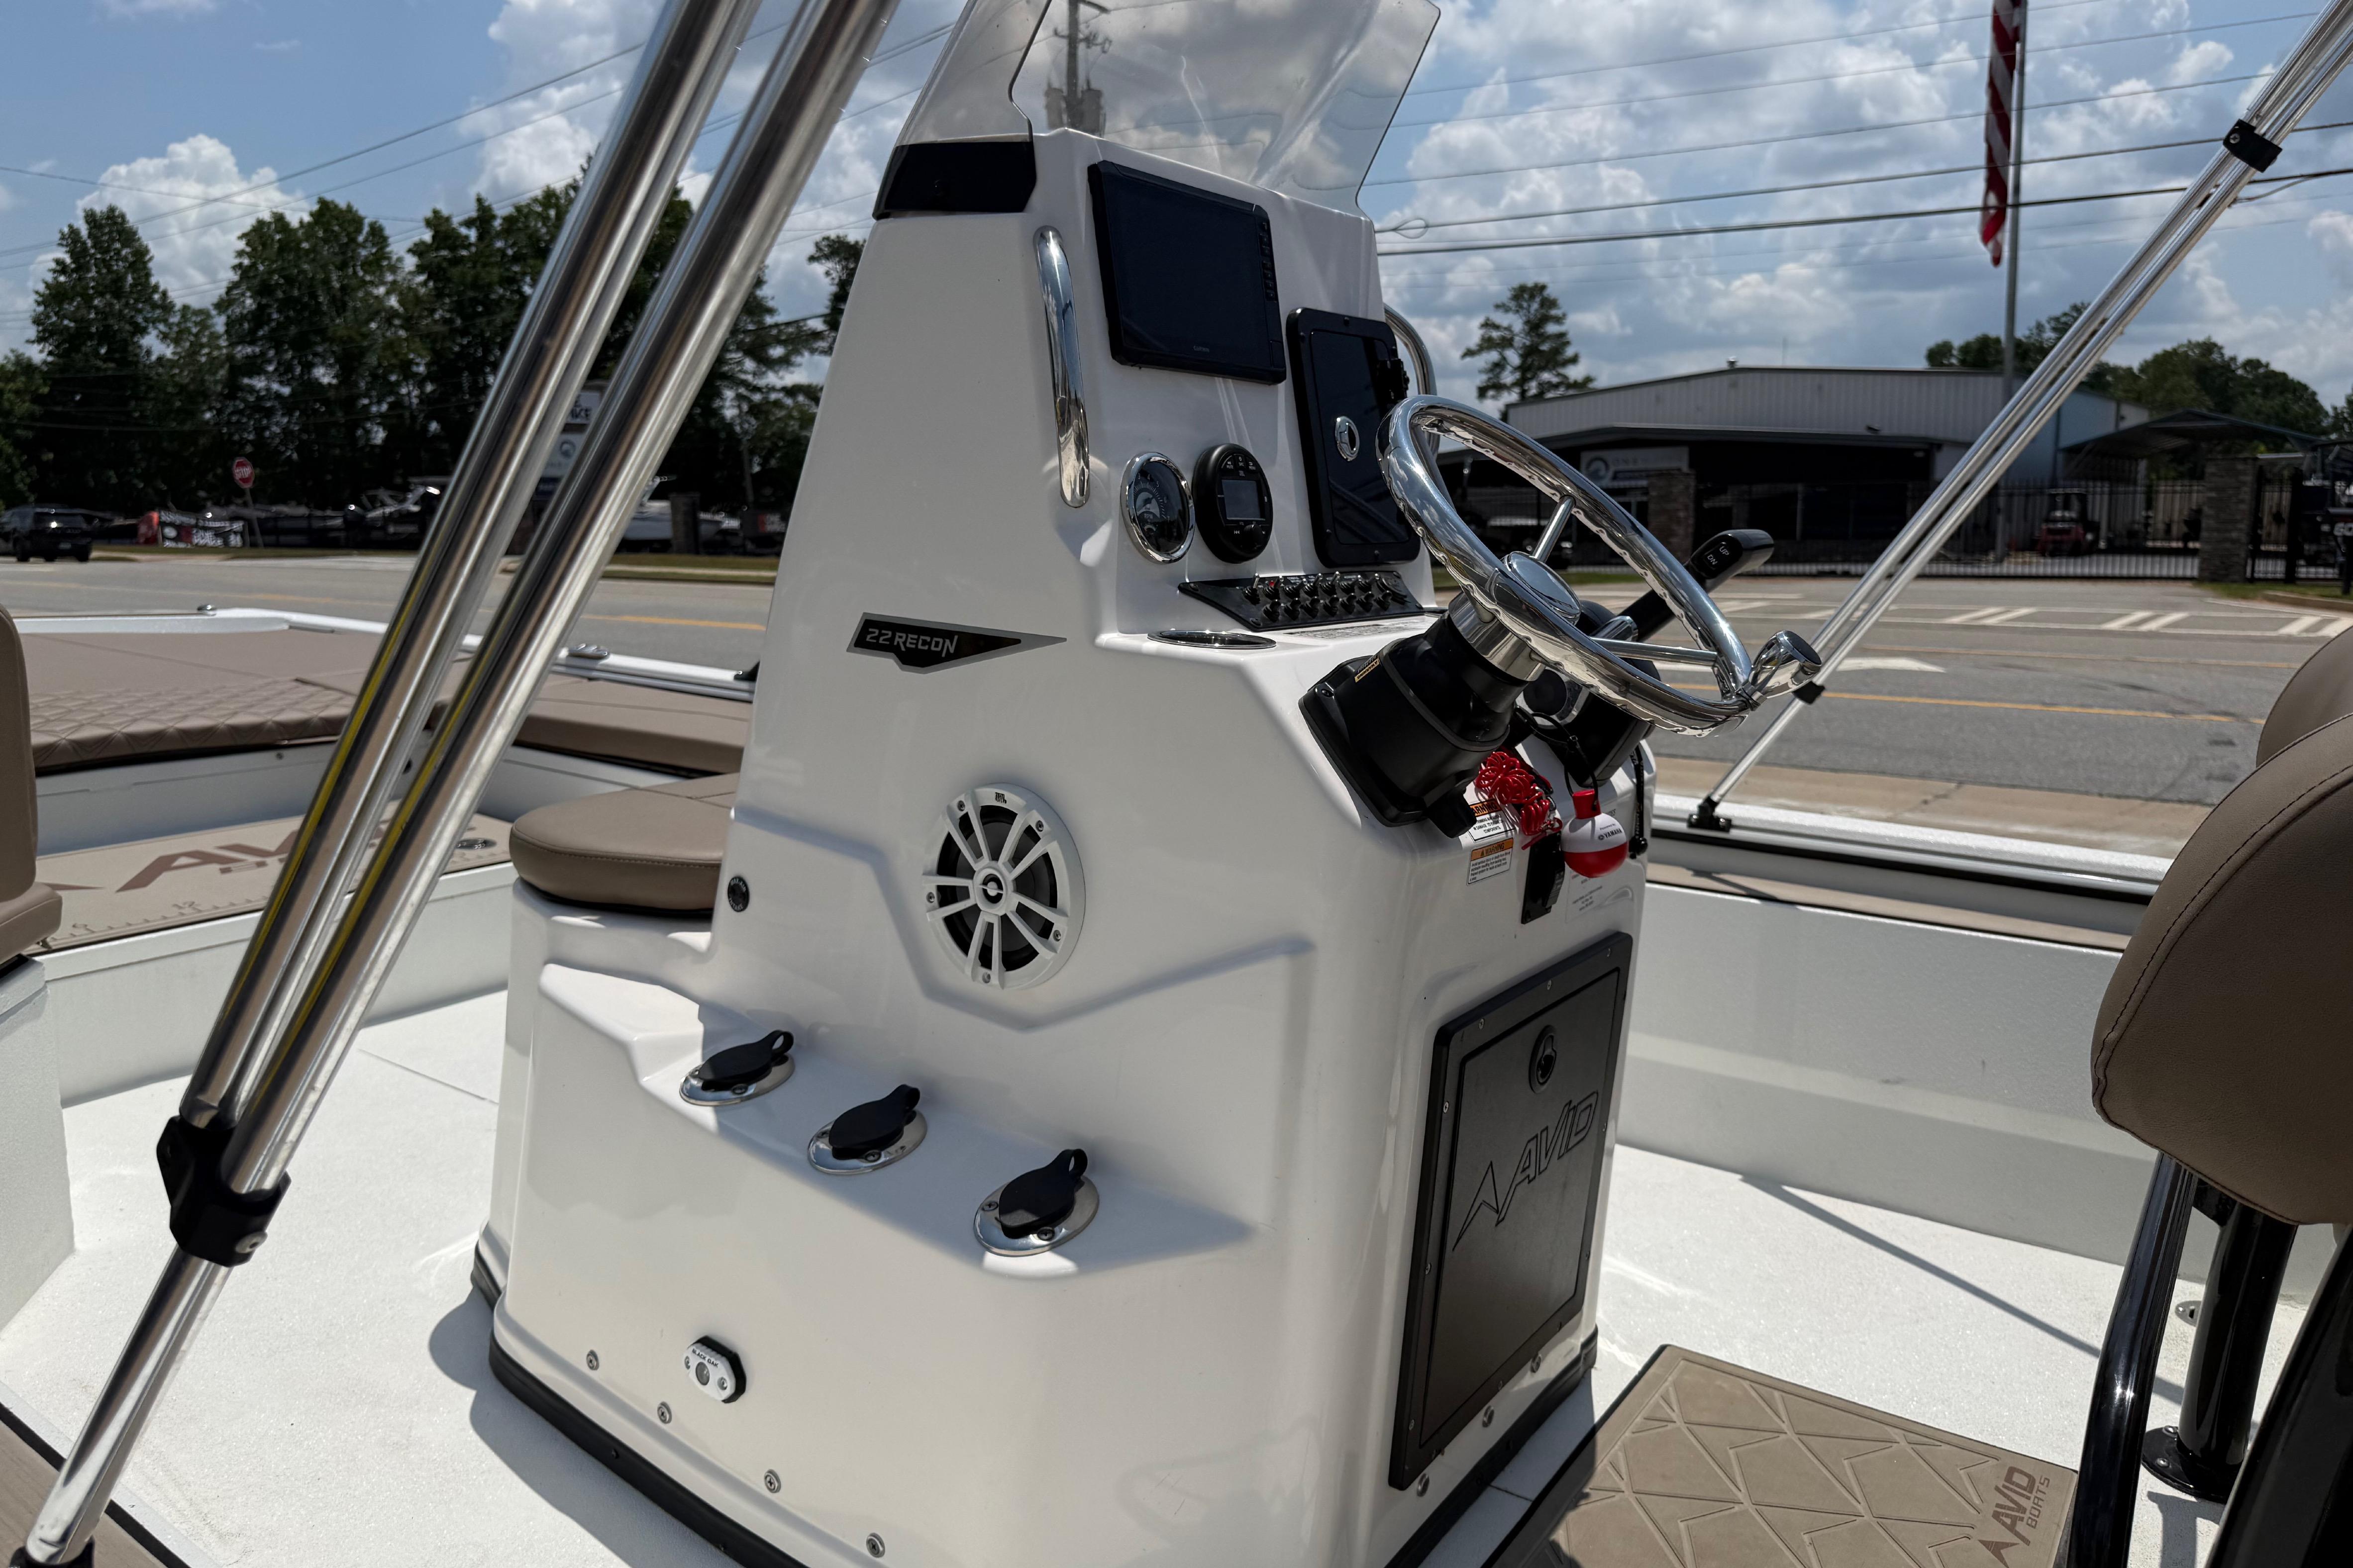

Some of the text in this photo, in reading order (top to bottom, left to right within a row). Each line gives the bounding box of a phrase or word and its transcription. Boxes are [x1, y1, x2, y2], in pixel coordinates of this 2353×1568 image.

[1707, 554, 1718, 565] DN
[1719, 546, 1730, 555] UP
[893, 632, 958, 657] RECON
[1604, 828, 1623, 839] YAMAHA
[1495, 1090, 1598, 1227] AVID
[692, 1348, 718, 1368] BLACK OAK
[1991, 1466, 2036, 1547] AVID
[2027, 1475, 2050, 1529] BOATS
